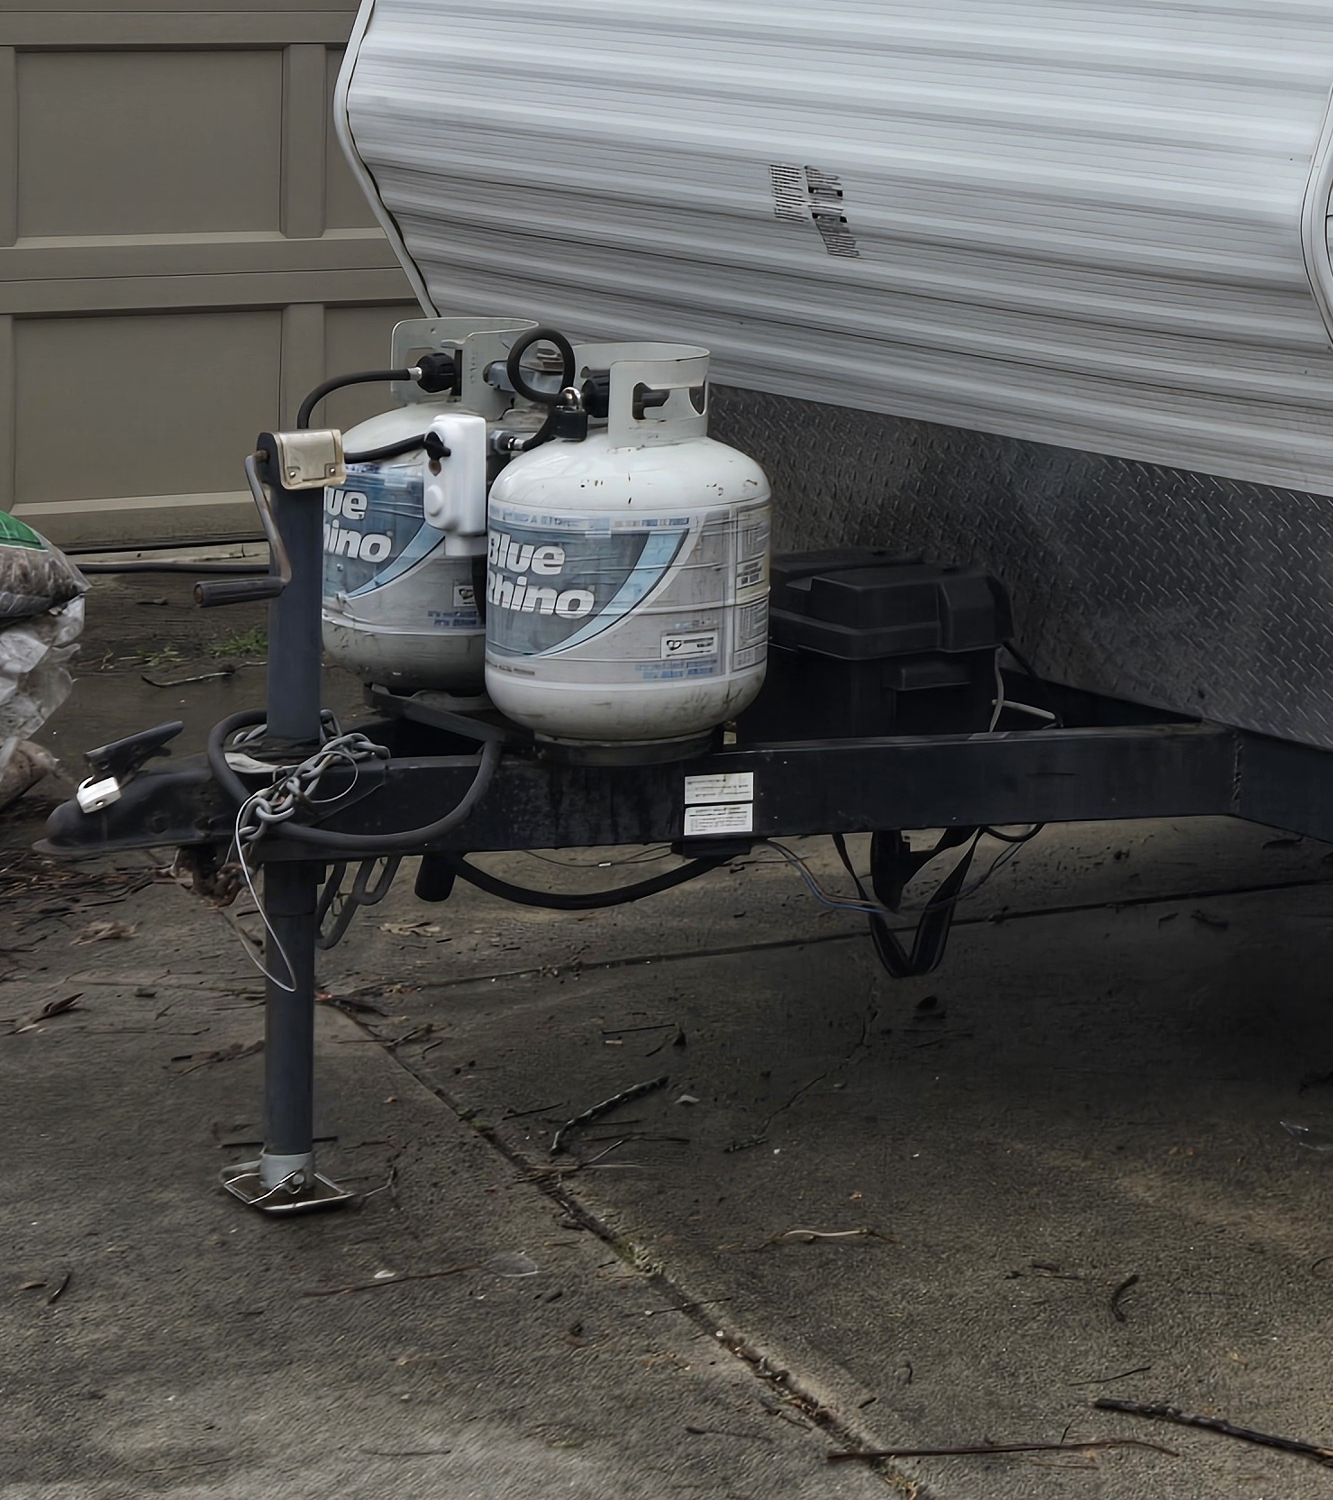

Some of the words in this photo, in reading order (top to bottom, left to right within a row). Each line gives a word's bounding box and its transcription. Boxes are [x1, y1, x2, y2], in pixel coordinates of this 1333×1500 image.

[323, 487, 368, 520] ue
[323, 519, 393, 564] ino
[489, 530, 566, 575] Blue
